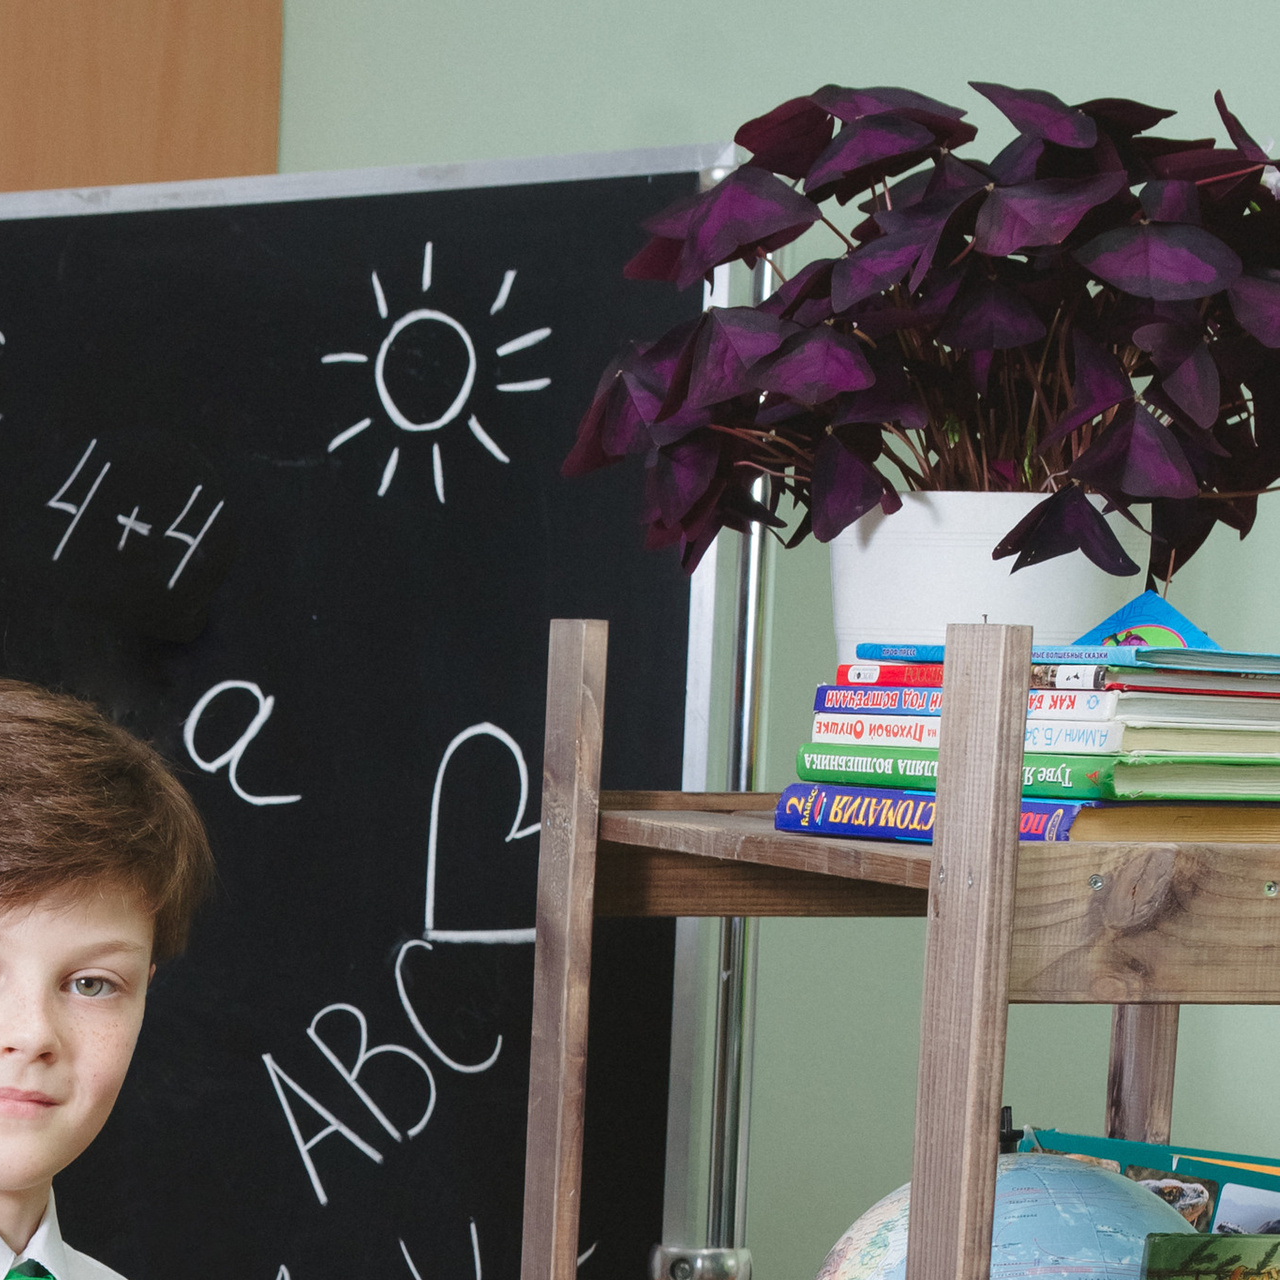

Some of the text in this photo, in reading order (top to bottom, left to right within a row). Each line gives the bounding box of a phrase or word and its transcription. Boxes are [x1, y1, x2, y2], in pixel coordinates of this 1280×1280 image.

[45, 438, 225, 589] 4+4
[825, 689, 898, 710] ВСТРЕЧАЛИ
[902, 691, 925, 710] ГОД
[1049, 694, 1077, 711] КАК
[803, 753, 894, 775] ВОЛШЕБНИКА
[1037, 763, 1073, 787] Туве
[786, 796, 805, 815] 2
[1020, 812, 1048, 834] ПО
